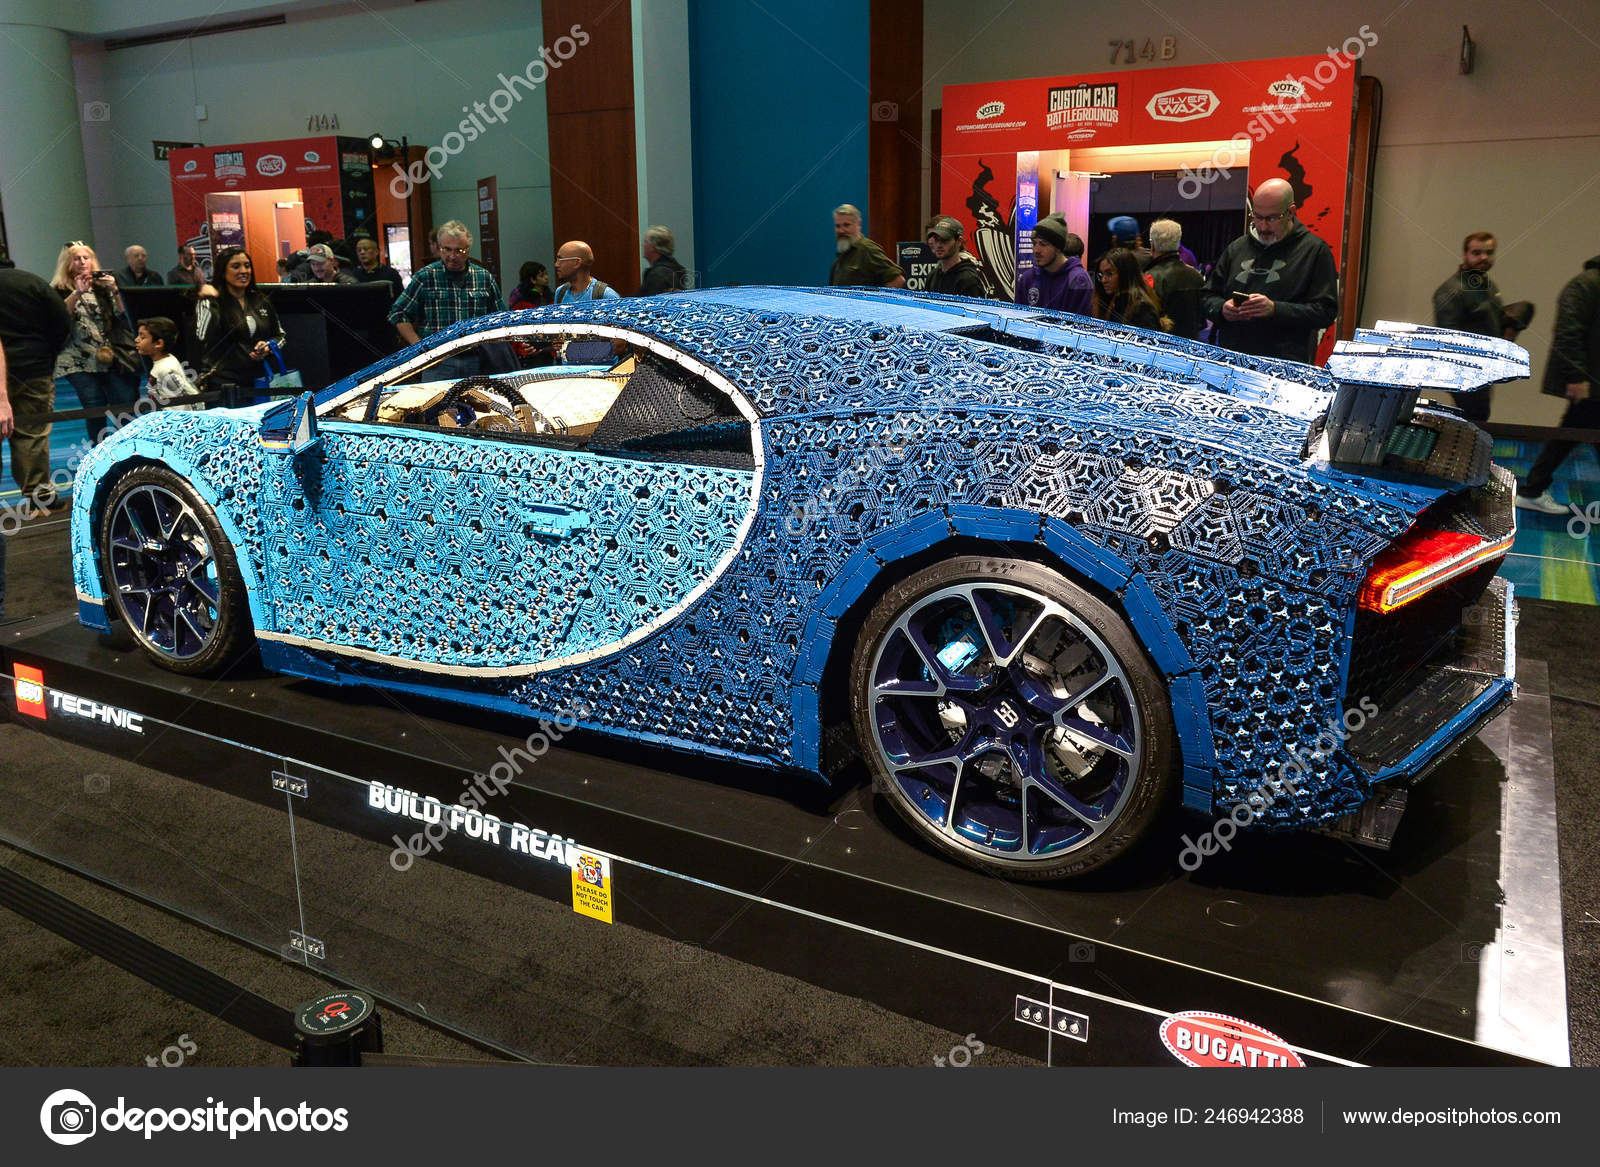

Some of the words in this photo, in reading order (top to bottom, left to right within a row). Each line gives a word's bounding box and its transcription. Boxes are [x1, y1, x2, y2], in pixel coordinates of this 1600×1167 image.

[1273, 83, 1300, 94] VOTE!
[1050, 88, 1090, 111] CUSTOM
[1093, 86, 1116, 108] CAR
[1157, 95, 1209, 105] SILVER
[979, 104, 1002, 116] VOTE!
[1158, 102, 1208, 115] WAX
[1046, 107, 1119, 127] BATTLEGROUNDS
[49, 690, 143, 734] TECHNIC
[369, 780, 441, 825] BUILD
[450, 804, 500, 845] FOR
[576, 884, 598, 896] PLEASE
[598, 891, 608, 899] DO
[576, 891, 588, 899] NOT
[588, 895, 609, 906] TOUCH
[580, 900, 591, 908] THE
[591, 904, 605, 912] CAR.
